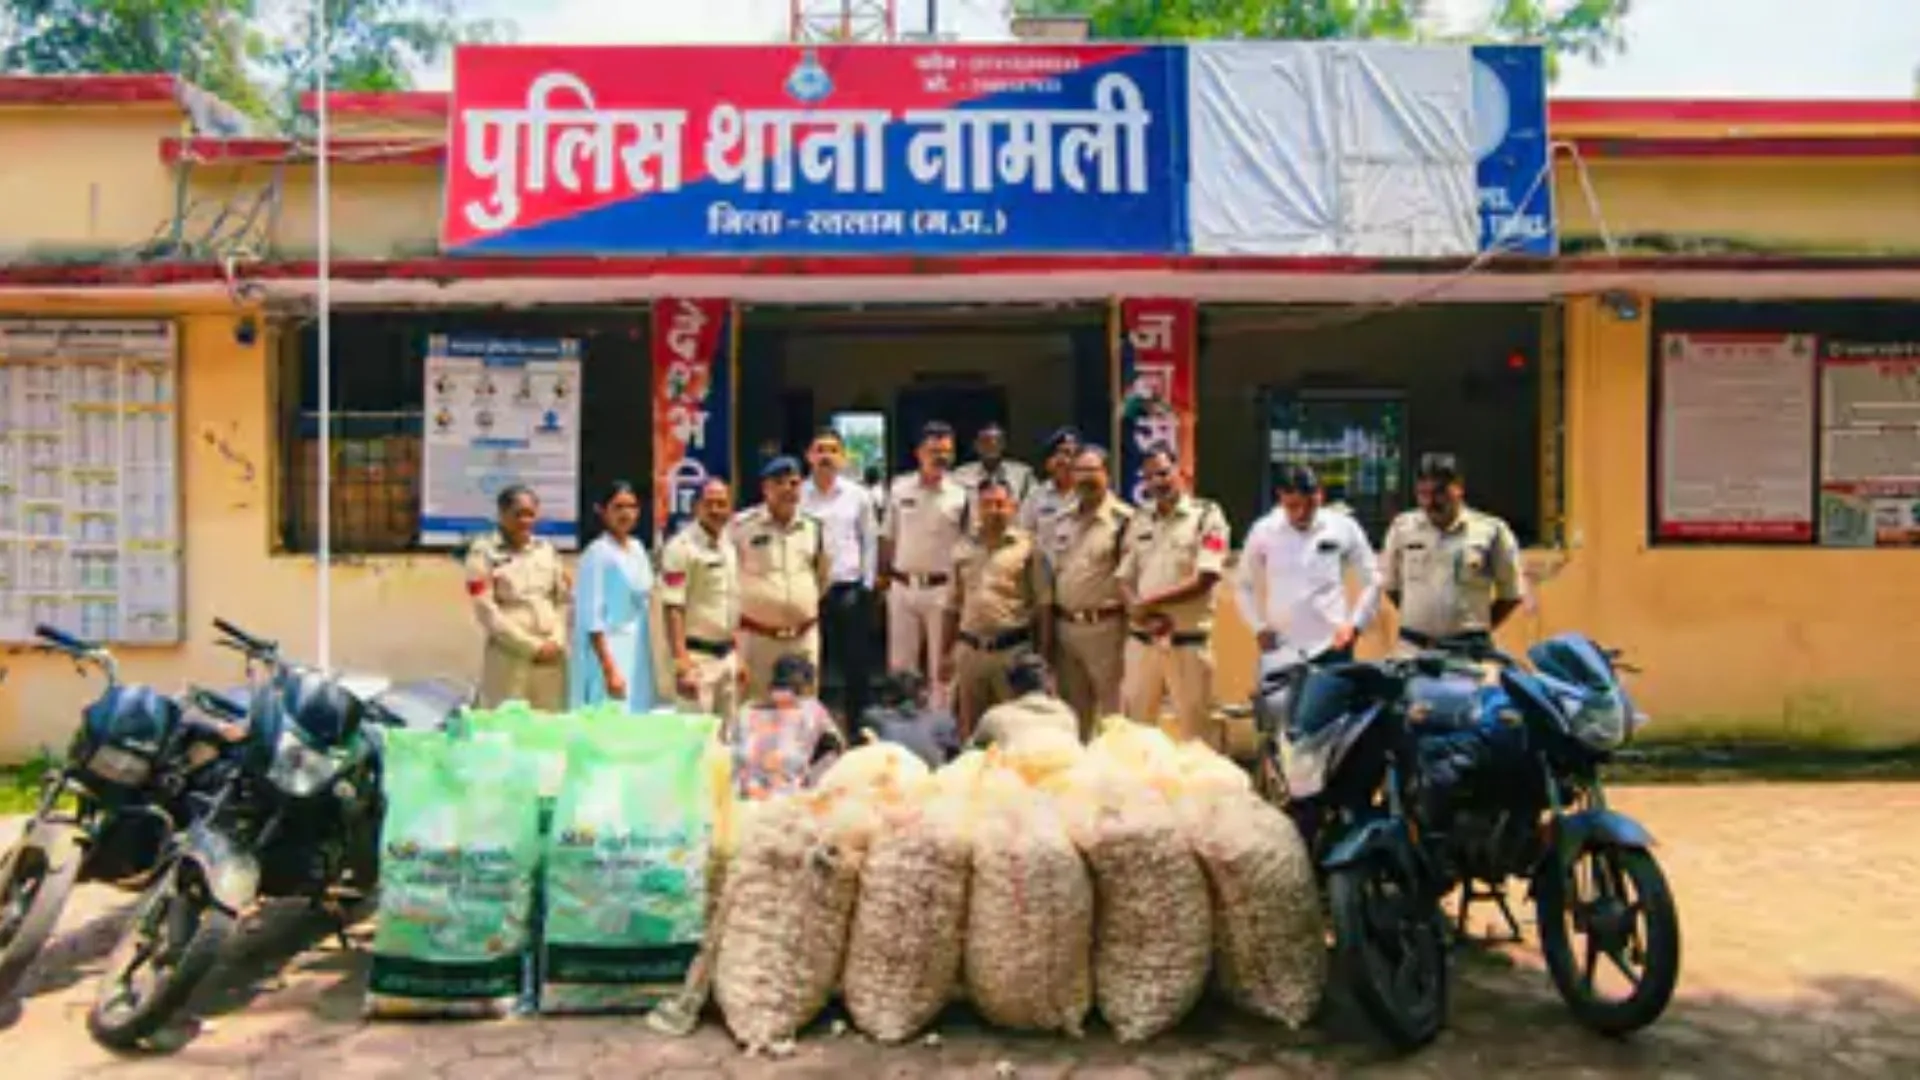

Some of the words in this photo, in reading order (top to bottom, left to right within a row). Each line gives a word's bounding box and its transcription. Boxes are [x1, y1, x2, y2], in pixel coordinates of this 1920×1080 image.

[462, 71, 689, 230] पुलिस
[705, 104, 893, 193] थाना
[905, 72, 1152, 194] नामली
[707, 200, 783, 235] जिला
[805, 209, 904, 236] रतलाम
